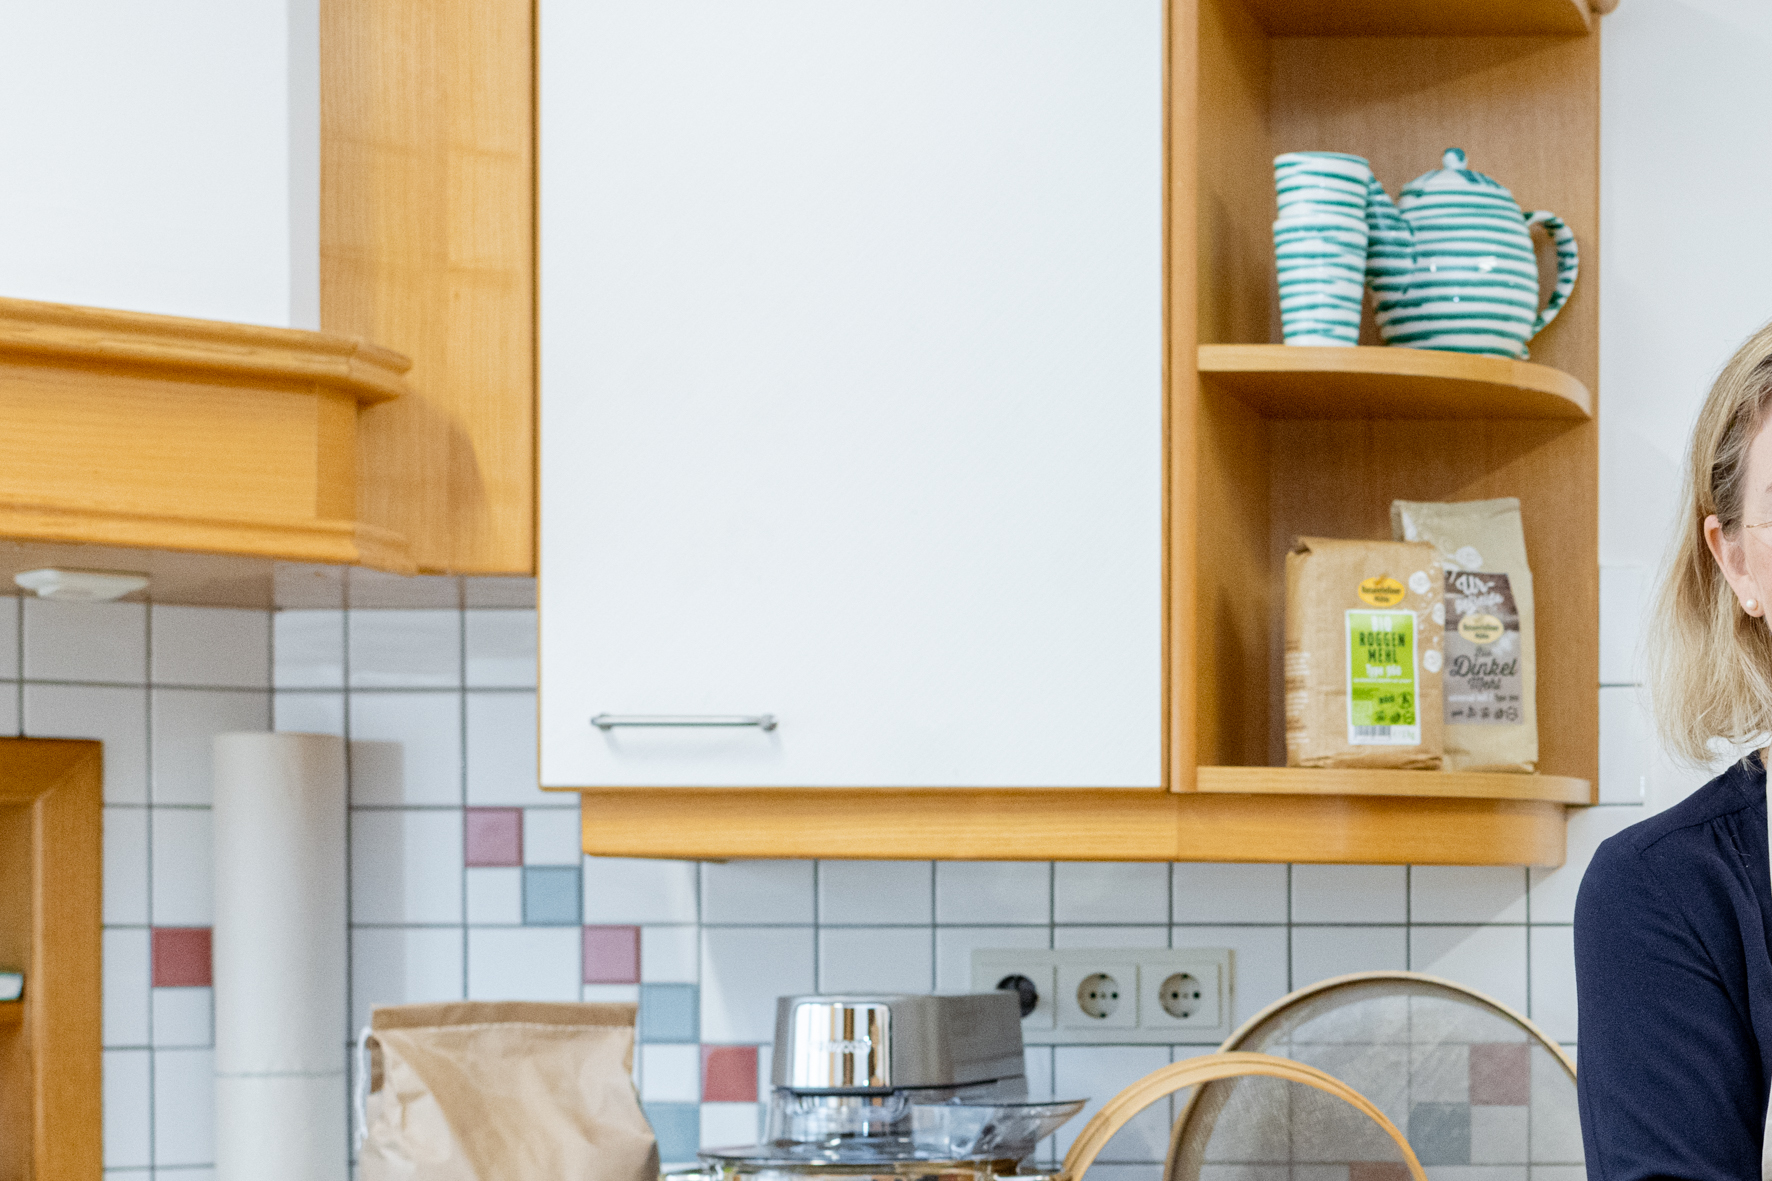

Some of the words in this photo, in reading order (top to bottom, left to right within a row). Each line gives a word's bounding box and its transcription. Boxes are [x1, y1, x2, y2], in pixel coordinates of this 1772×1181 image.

[1359, 631, 1406, 647] ROGGEN
[1367, 646, 1398, 663] MEHL
[1449, 654, 1517, 677] Dinkel
